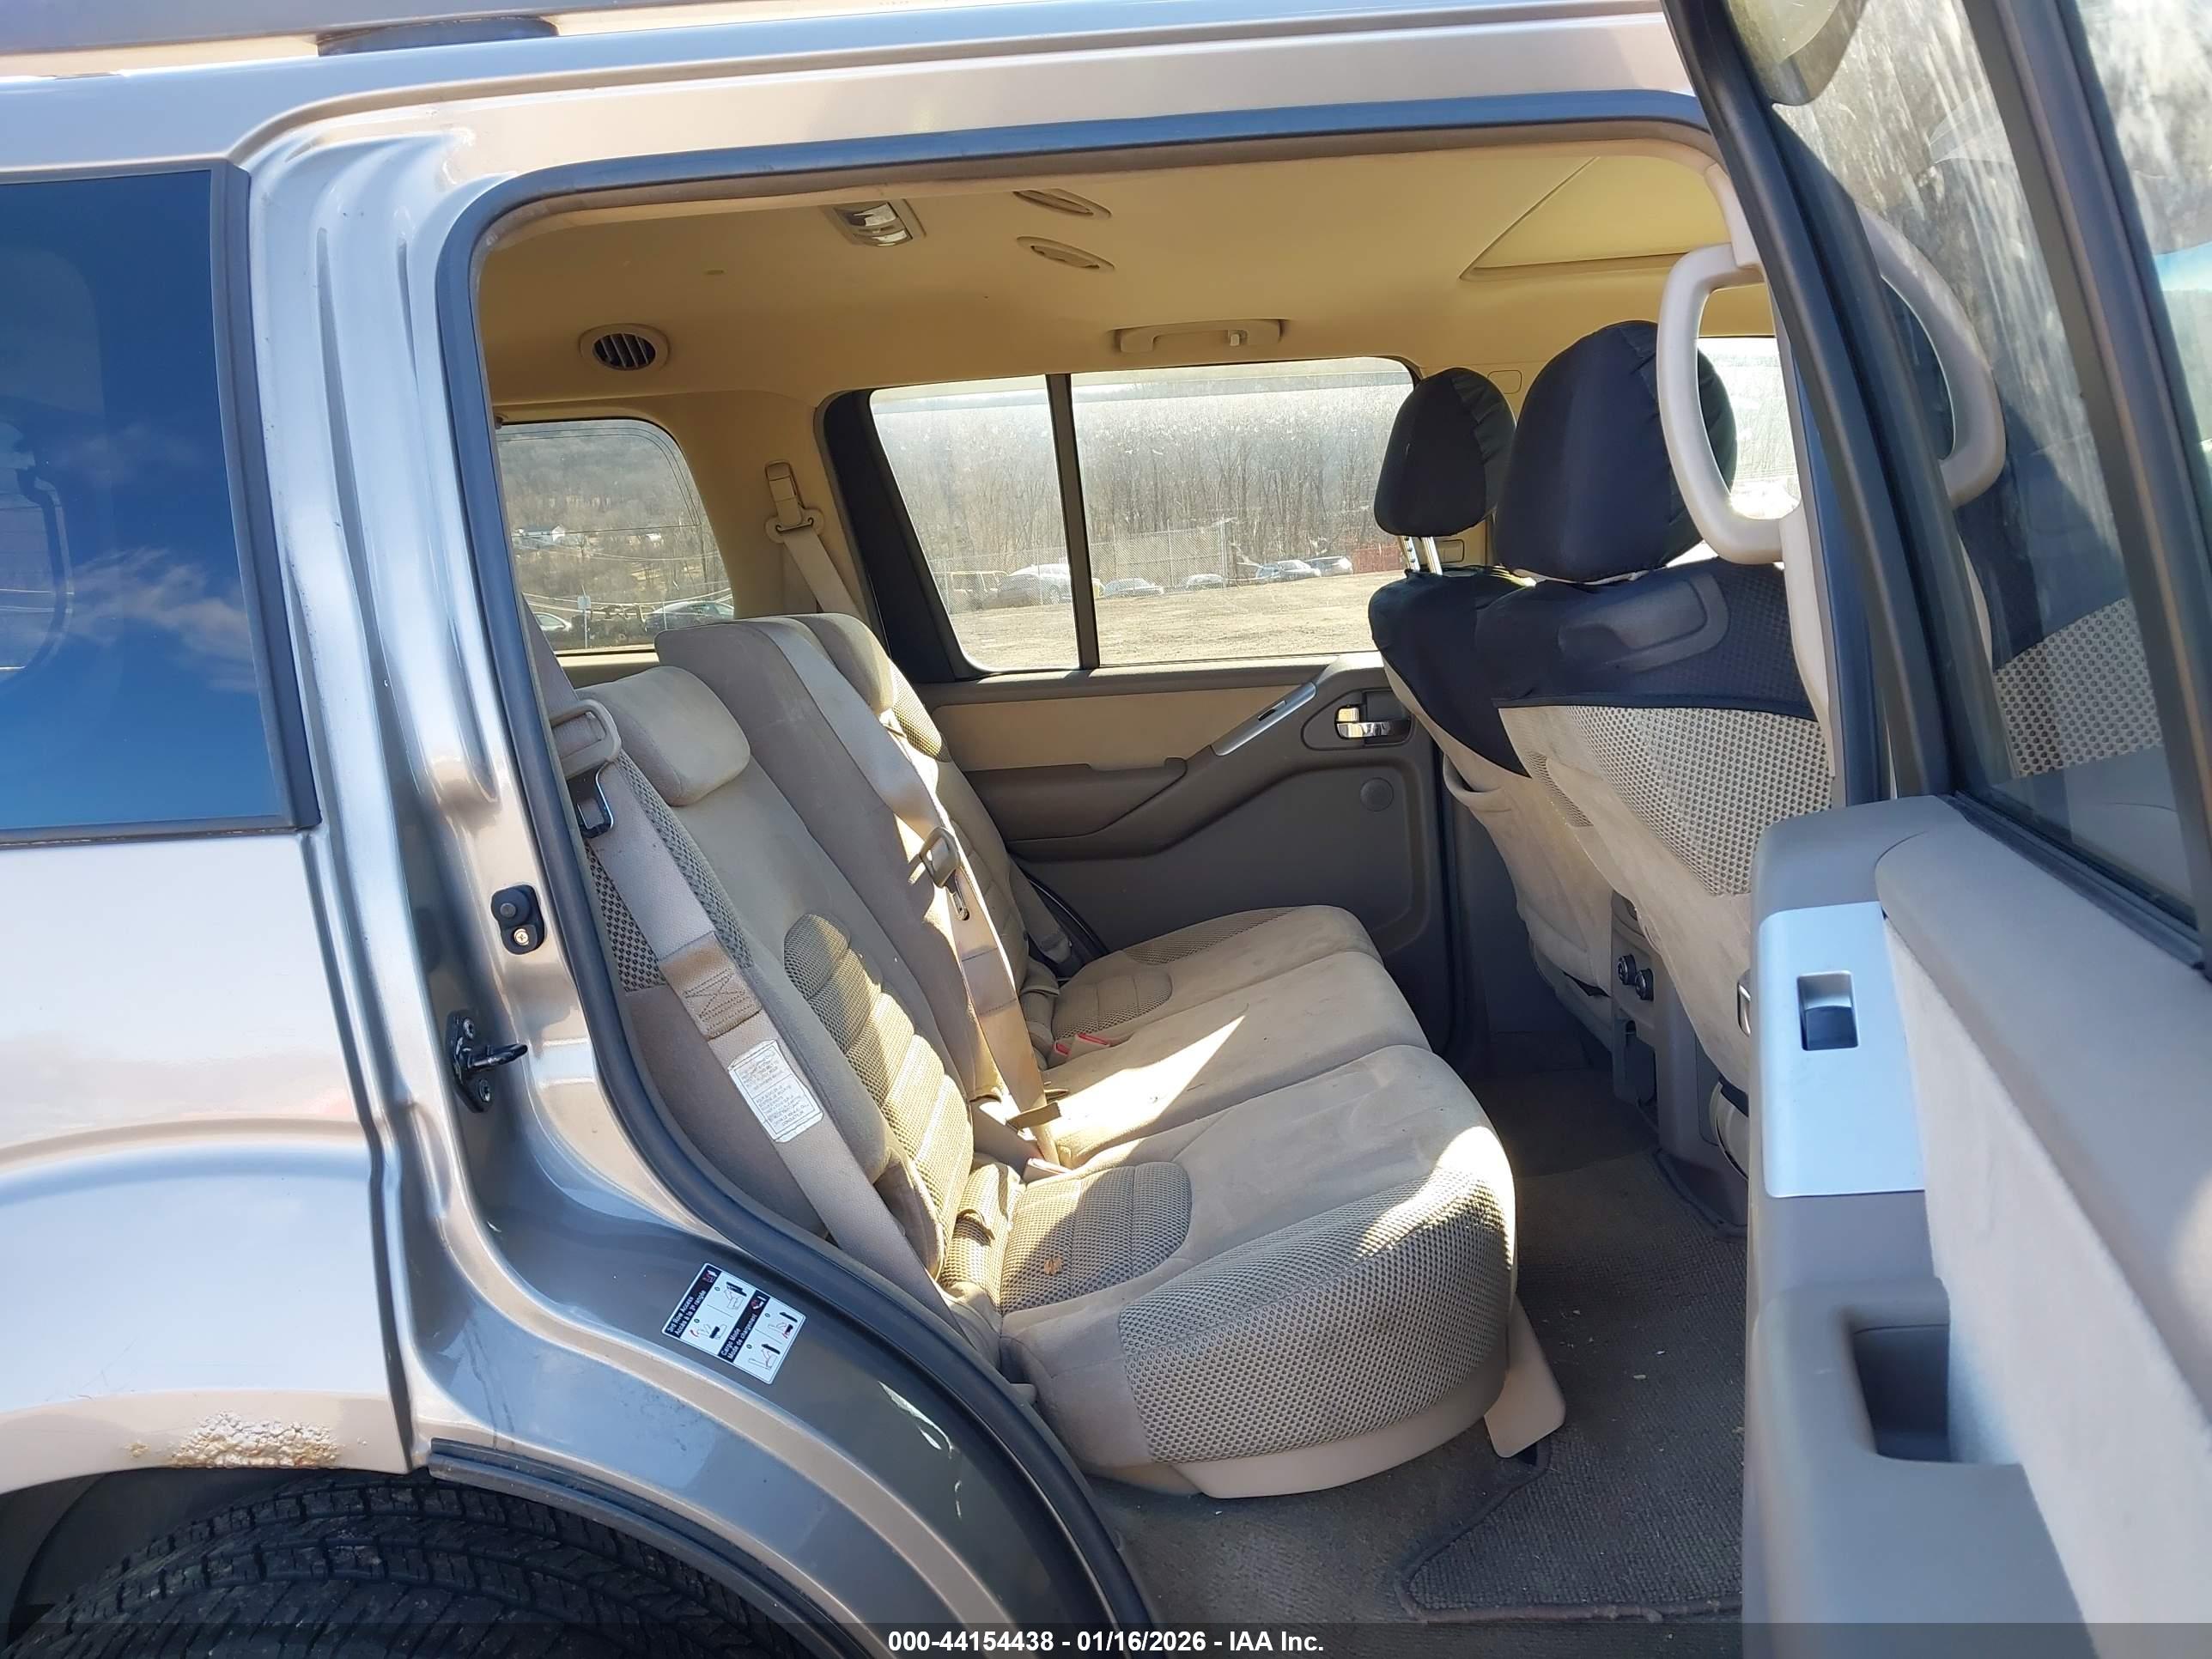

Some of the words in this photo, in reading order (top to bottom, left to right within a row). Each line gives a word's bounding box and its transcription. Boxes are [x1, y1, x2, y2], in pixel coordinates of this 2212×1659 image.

[667, 1323, 677, 1332] 3rd
[672, 1312, 684, 1323] Row
[680, 1296, 694, 1313] Access
[674, 1321, 687, 1335] Accès
[694, 1290, 706, 1305] rangée
[721, 1341, 732, 1355] Cargo
[729, 1328, 741, 1340] Mode
[727, 1346, 738, 1359] Mode
[740, 1314, 757, 1339] chargement
